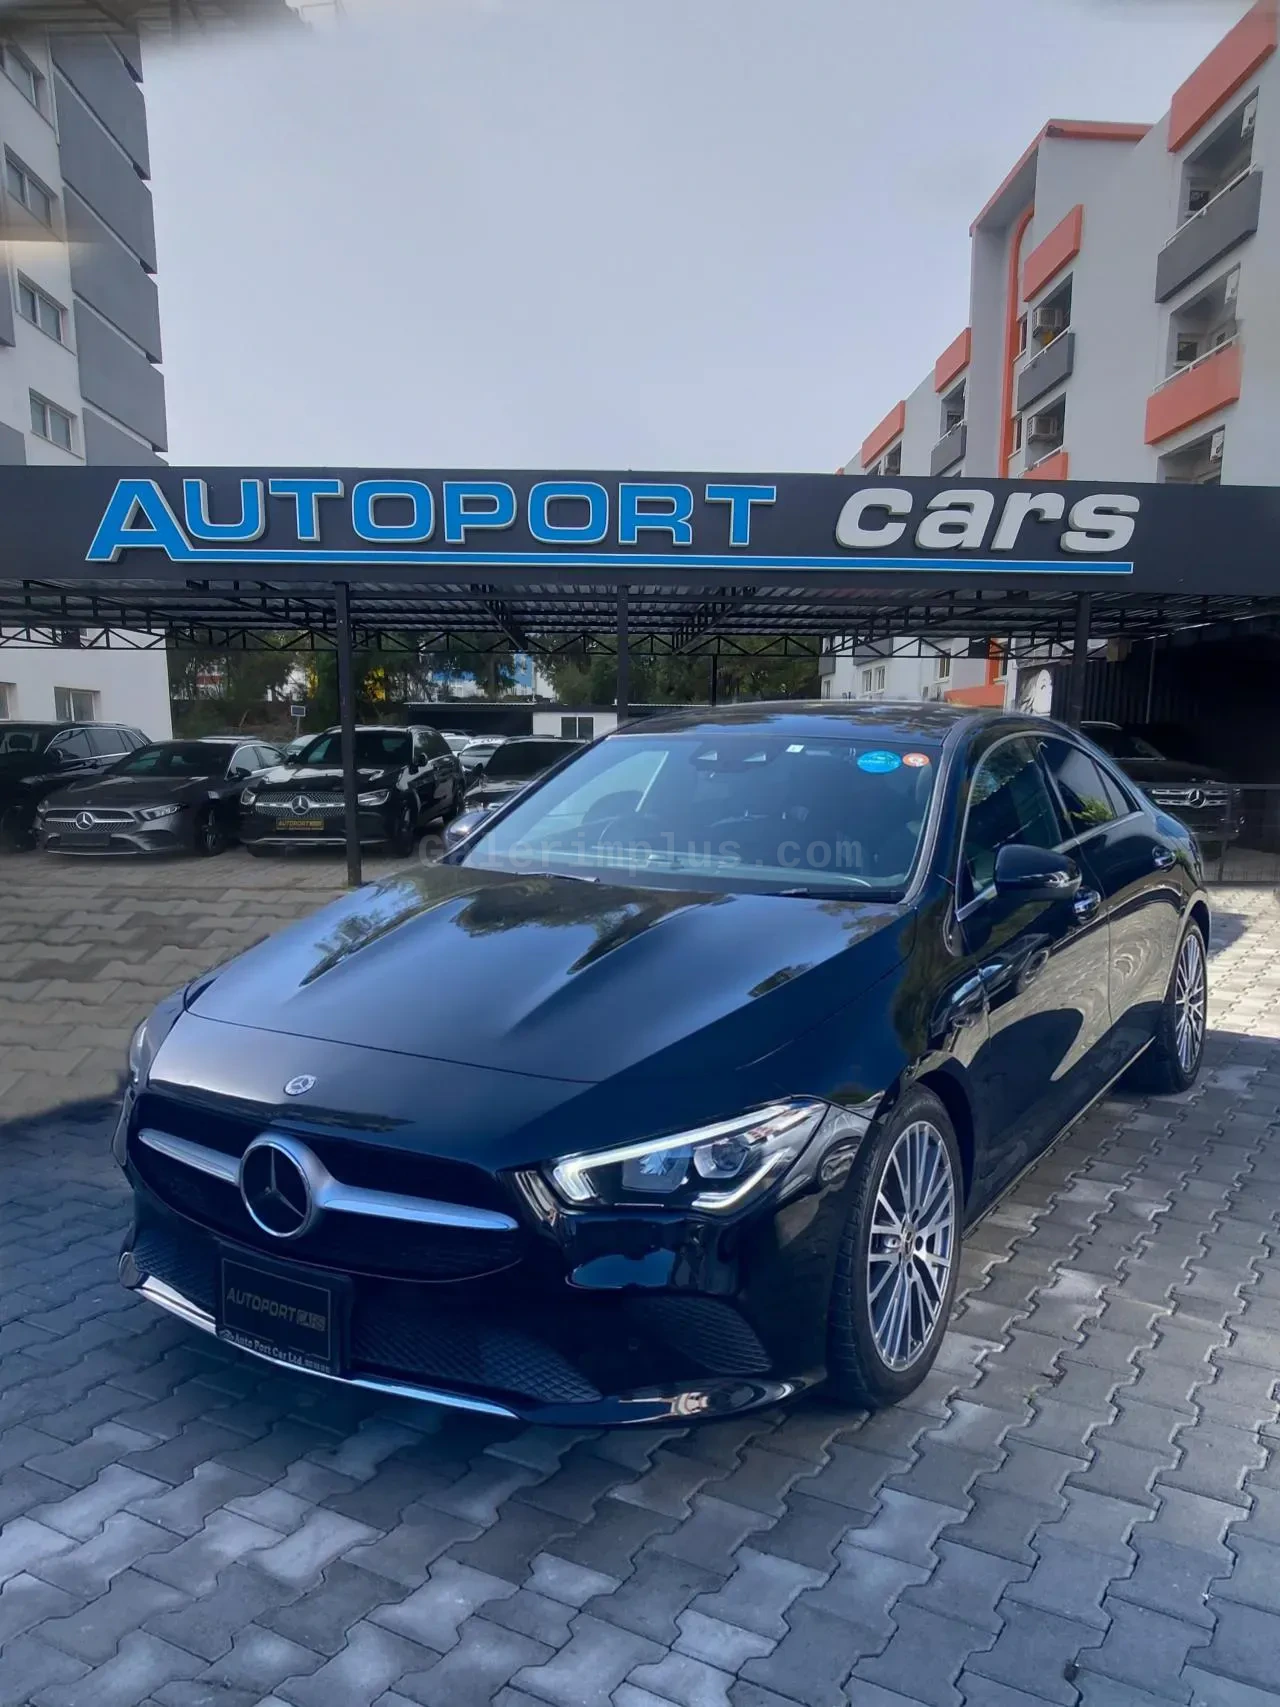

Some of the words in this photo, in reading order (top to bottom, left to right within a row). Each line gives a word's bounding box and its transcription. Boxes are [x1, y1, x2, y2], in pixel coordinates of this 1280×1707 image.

[85, 478, 777, 562] AUTOPORT
[835, 488, 1141, 553] cars
[226, 1288, 296, 1321] AUTOPORT
